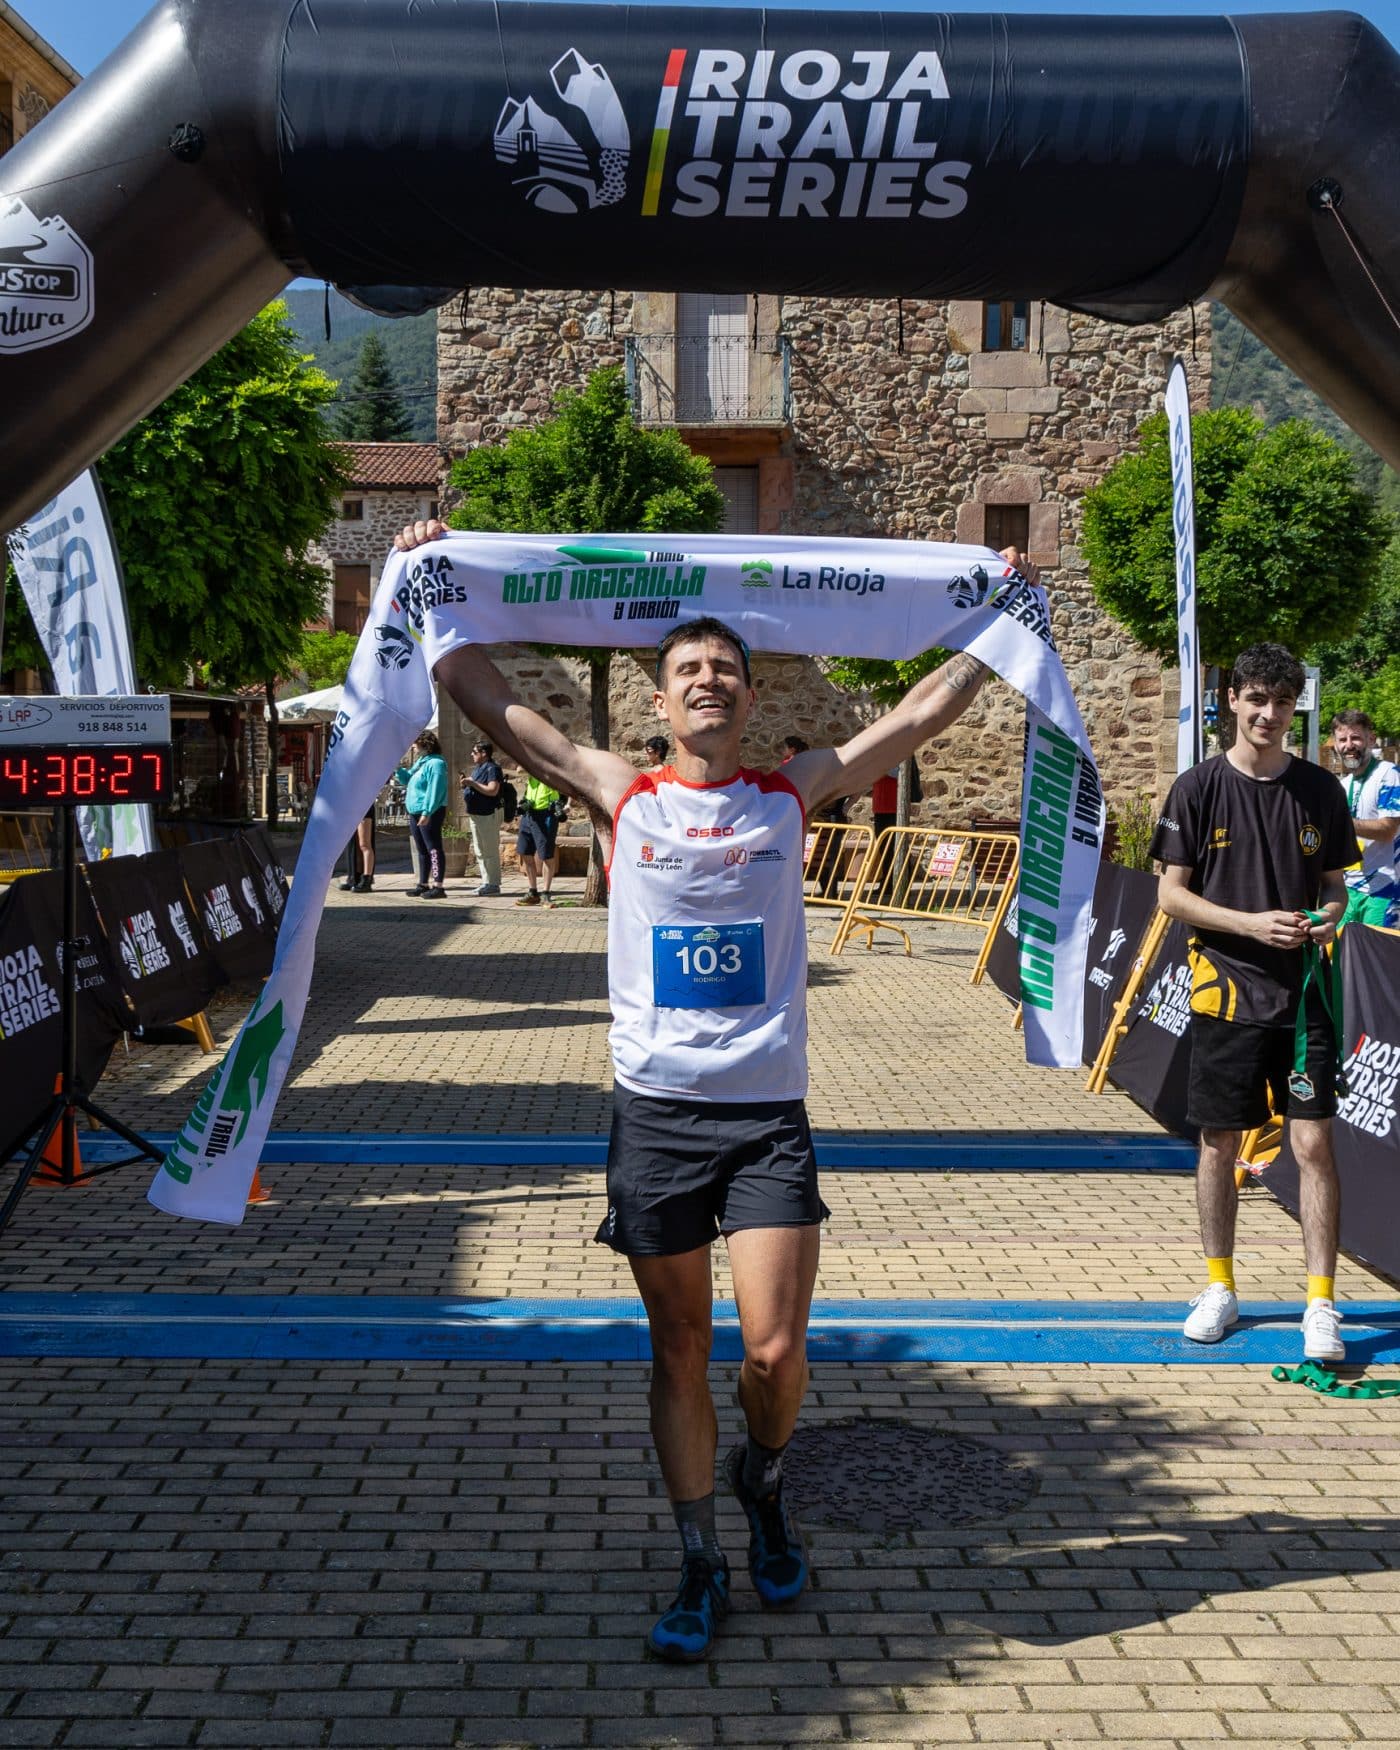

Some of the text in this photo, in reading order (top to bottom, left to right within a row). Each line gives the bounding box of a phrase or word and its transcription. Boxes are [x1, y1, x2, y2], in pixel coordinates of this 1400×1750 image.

[688, 48, 950, 101] RIOJA
[684, 100, 938, 159] TRAIL
[671, 160, 973, 219] SERIES
[502, 571, 563, 604] ALTO
[569, 565, 707, 601] NAJERILLA
[782, 565, 886, 596] La Rioja
[627, 597, 681, 620] URBIÓN
[8, 710, 31, 723] LAP
[59, 703, 165, 712] SERVICIOS DEPORTIVOS
[78, 722, 147, 732] 918 848 514
[4, 755, 161, 795] 4:38:27
[1159, 816, 1180, 832] Rioja
[636, 861, 660, 870] Castilla
[654, 856, 683, 864] Junta de
[675, 943, 743, 975] 103
[1, 987, 61, 1038] SERIES
[1152, 1002, 1192, 1038] SERIES
[1346, 1061, 1399, 1107] TRAIL
[204, 1113, 239, 1158] TRAIL
